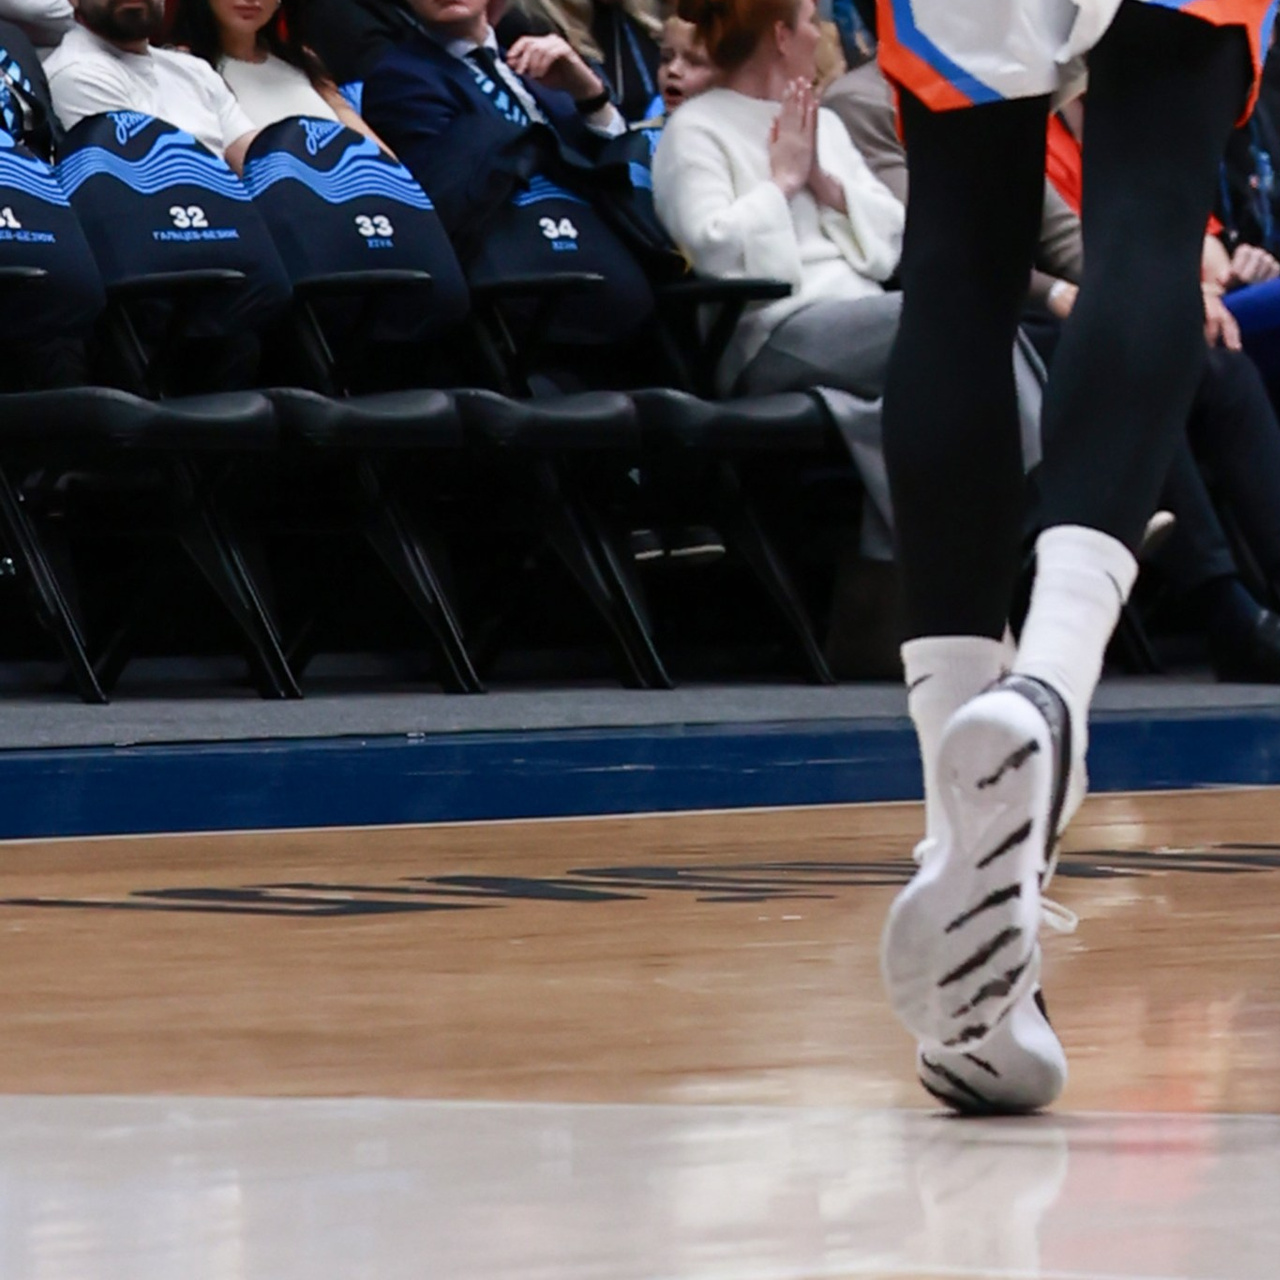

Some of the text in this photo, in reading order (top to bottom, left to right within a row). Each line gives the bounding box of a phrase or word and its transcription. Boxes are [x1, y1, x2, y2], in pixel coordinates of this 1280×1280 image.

[169, 205, 209, 228] 32
[355, 214, 394, 237] 33
[539, 217, 579, 239] 34
